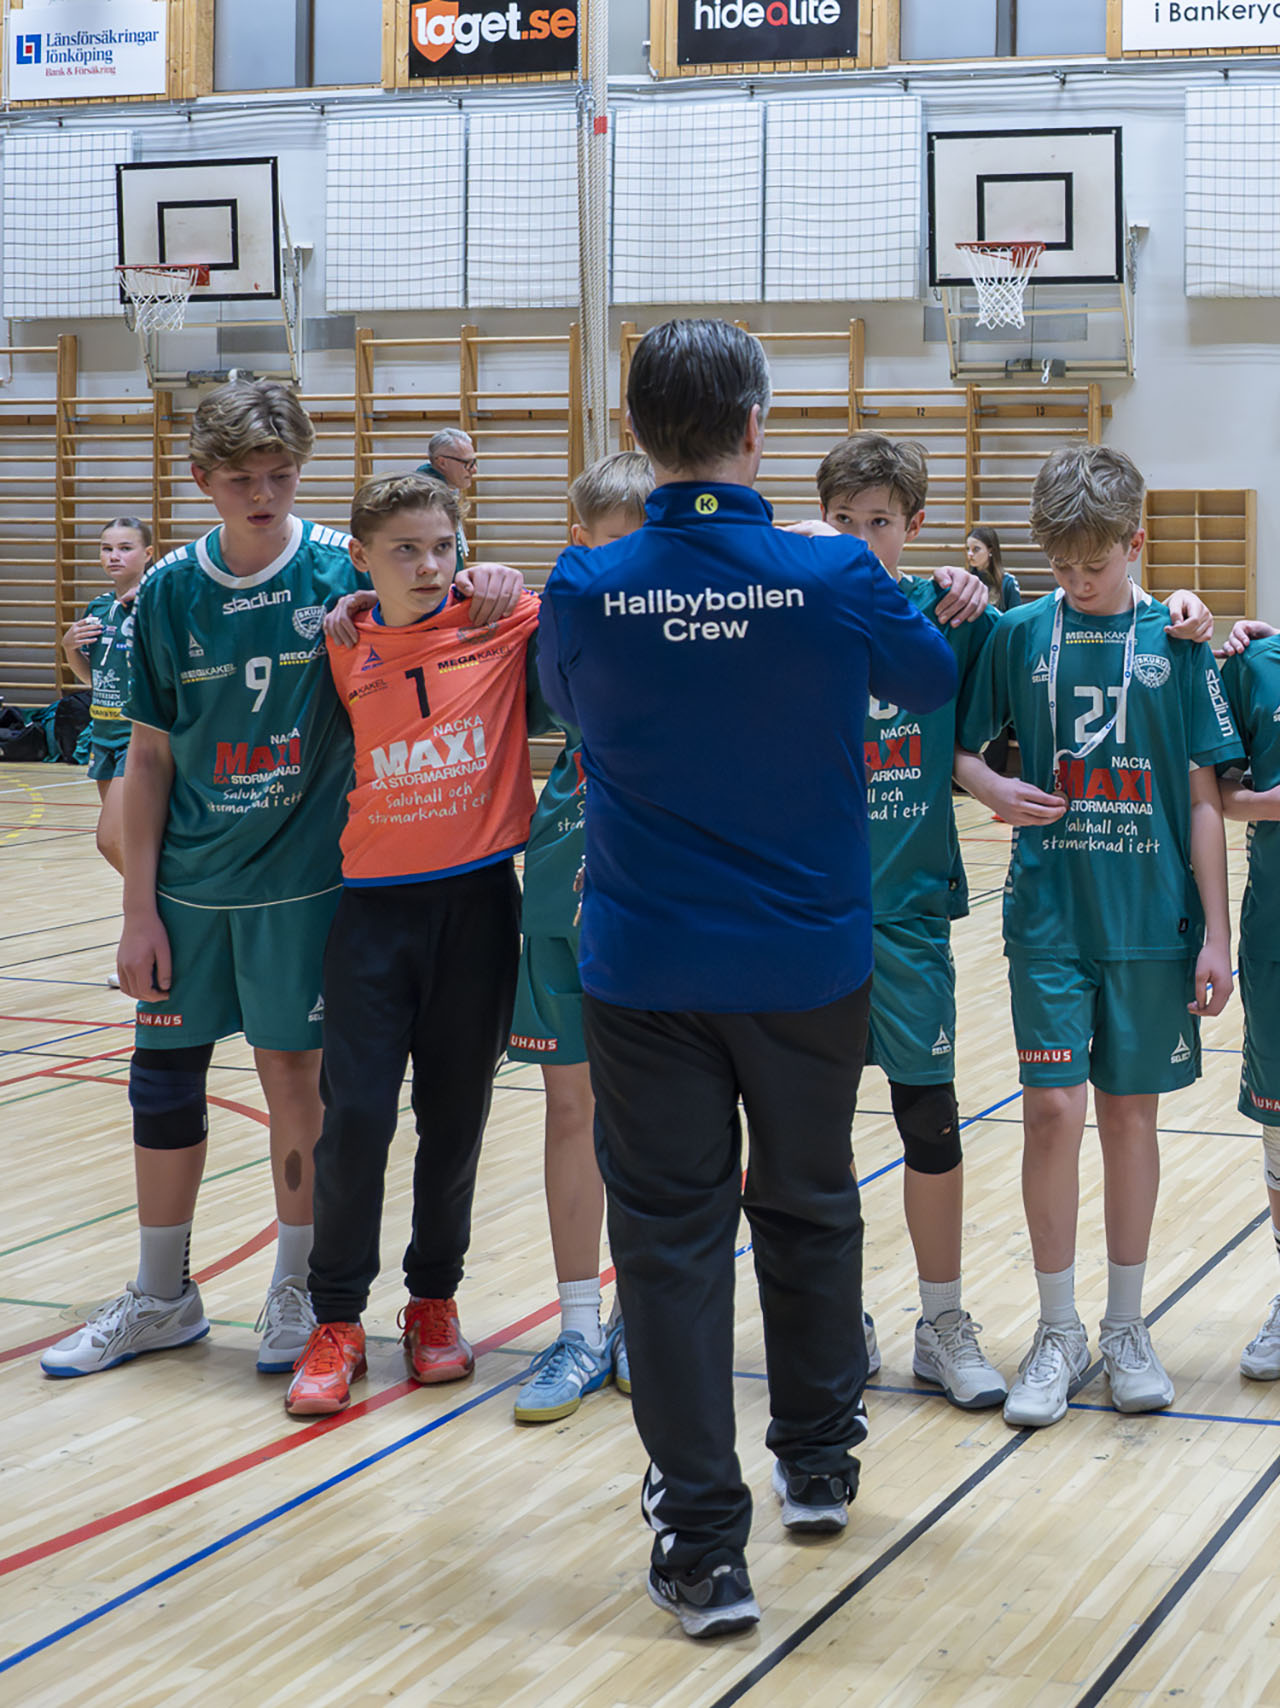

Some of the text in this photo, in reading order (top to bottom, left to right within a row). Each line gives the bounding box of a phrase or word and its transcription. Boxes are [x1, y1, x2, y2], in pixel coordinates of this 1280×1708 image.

[694, 0, 840, 30] hidealite
[1155, 2, 1159, 23] i
[46, 29, 159, 47] Länsförsäkringar
[415, 2, 577, 54] laget.se
[46, 48, 113, 65] Jönköping
[222, 589, 291, 615] stadium
[604, 584, 804, 616] Hallbybollen
[663, 618, 749, 642] Crew
[101, 637, 113, 666] 7
[245, 656, 272, 712] 9
[405, 666, 430, 719] 1
[1074, 686, 1126, 744] 21
[1205, 669, 1234, 737] stadium
[433, 715, 483, 736] NACKA
[880, 723, 921, 740] NACKA
[214, 738, 301, 774] MAXI
[371, 726, 486, 779] MAXI
[864, 735, 921, 770] AXI
[389, 759, 487, 789] STORMARKNAD
[871, 768, 921, 783] ARKNAD
[1059, 760, 1152, 802] MAXI
[385, 782, 472, 808] Saluhall och
[462, 798, 467, 811] i
[881, 787, 903, 802] och
[893, 805, 897, 818] i
[903, 802, 929, 818] ett
[1117, 820, 1138, 836] och
[1129, 838, 1133, 853] i
[1137, 838, 1160, 854] ett
[138, 1014, 182, 1025] UHAUS
[308, 1013, 324, 1022] SEL
[511, 1035, 557, 1050] UHAUS
[1020, 1050, 1071, 1062] AUHAUS
